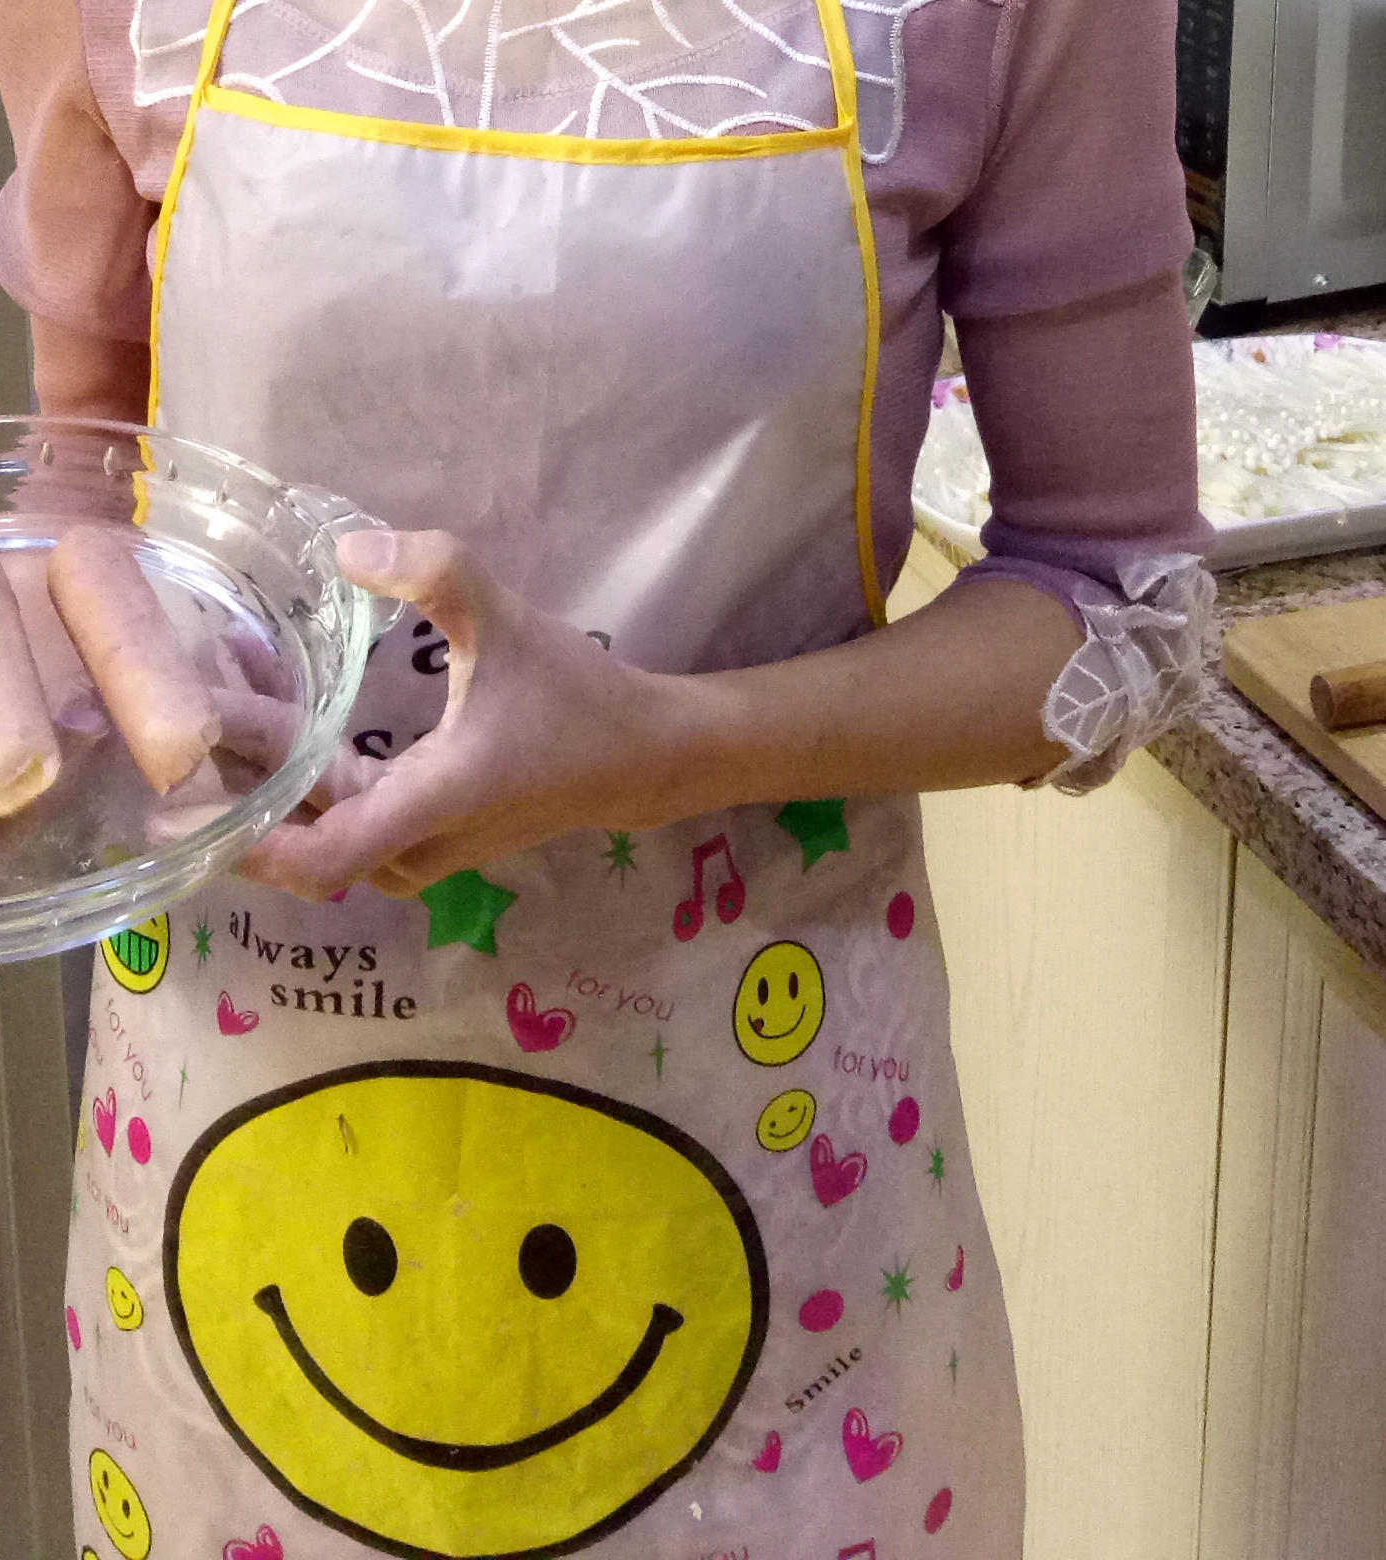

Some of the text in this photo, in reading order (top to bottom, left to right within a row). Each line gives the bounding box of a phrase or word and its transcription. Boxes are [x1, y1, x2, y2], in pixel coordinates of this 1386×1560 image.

[228, 910, 378, 984] always
[269, 977, 418, 1020] smile
[566, 968, 676, 1023] for you
[833, 1044, 910, 1083] for you
